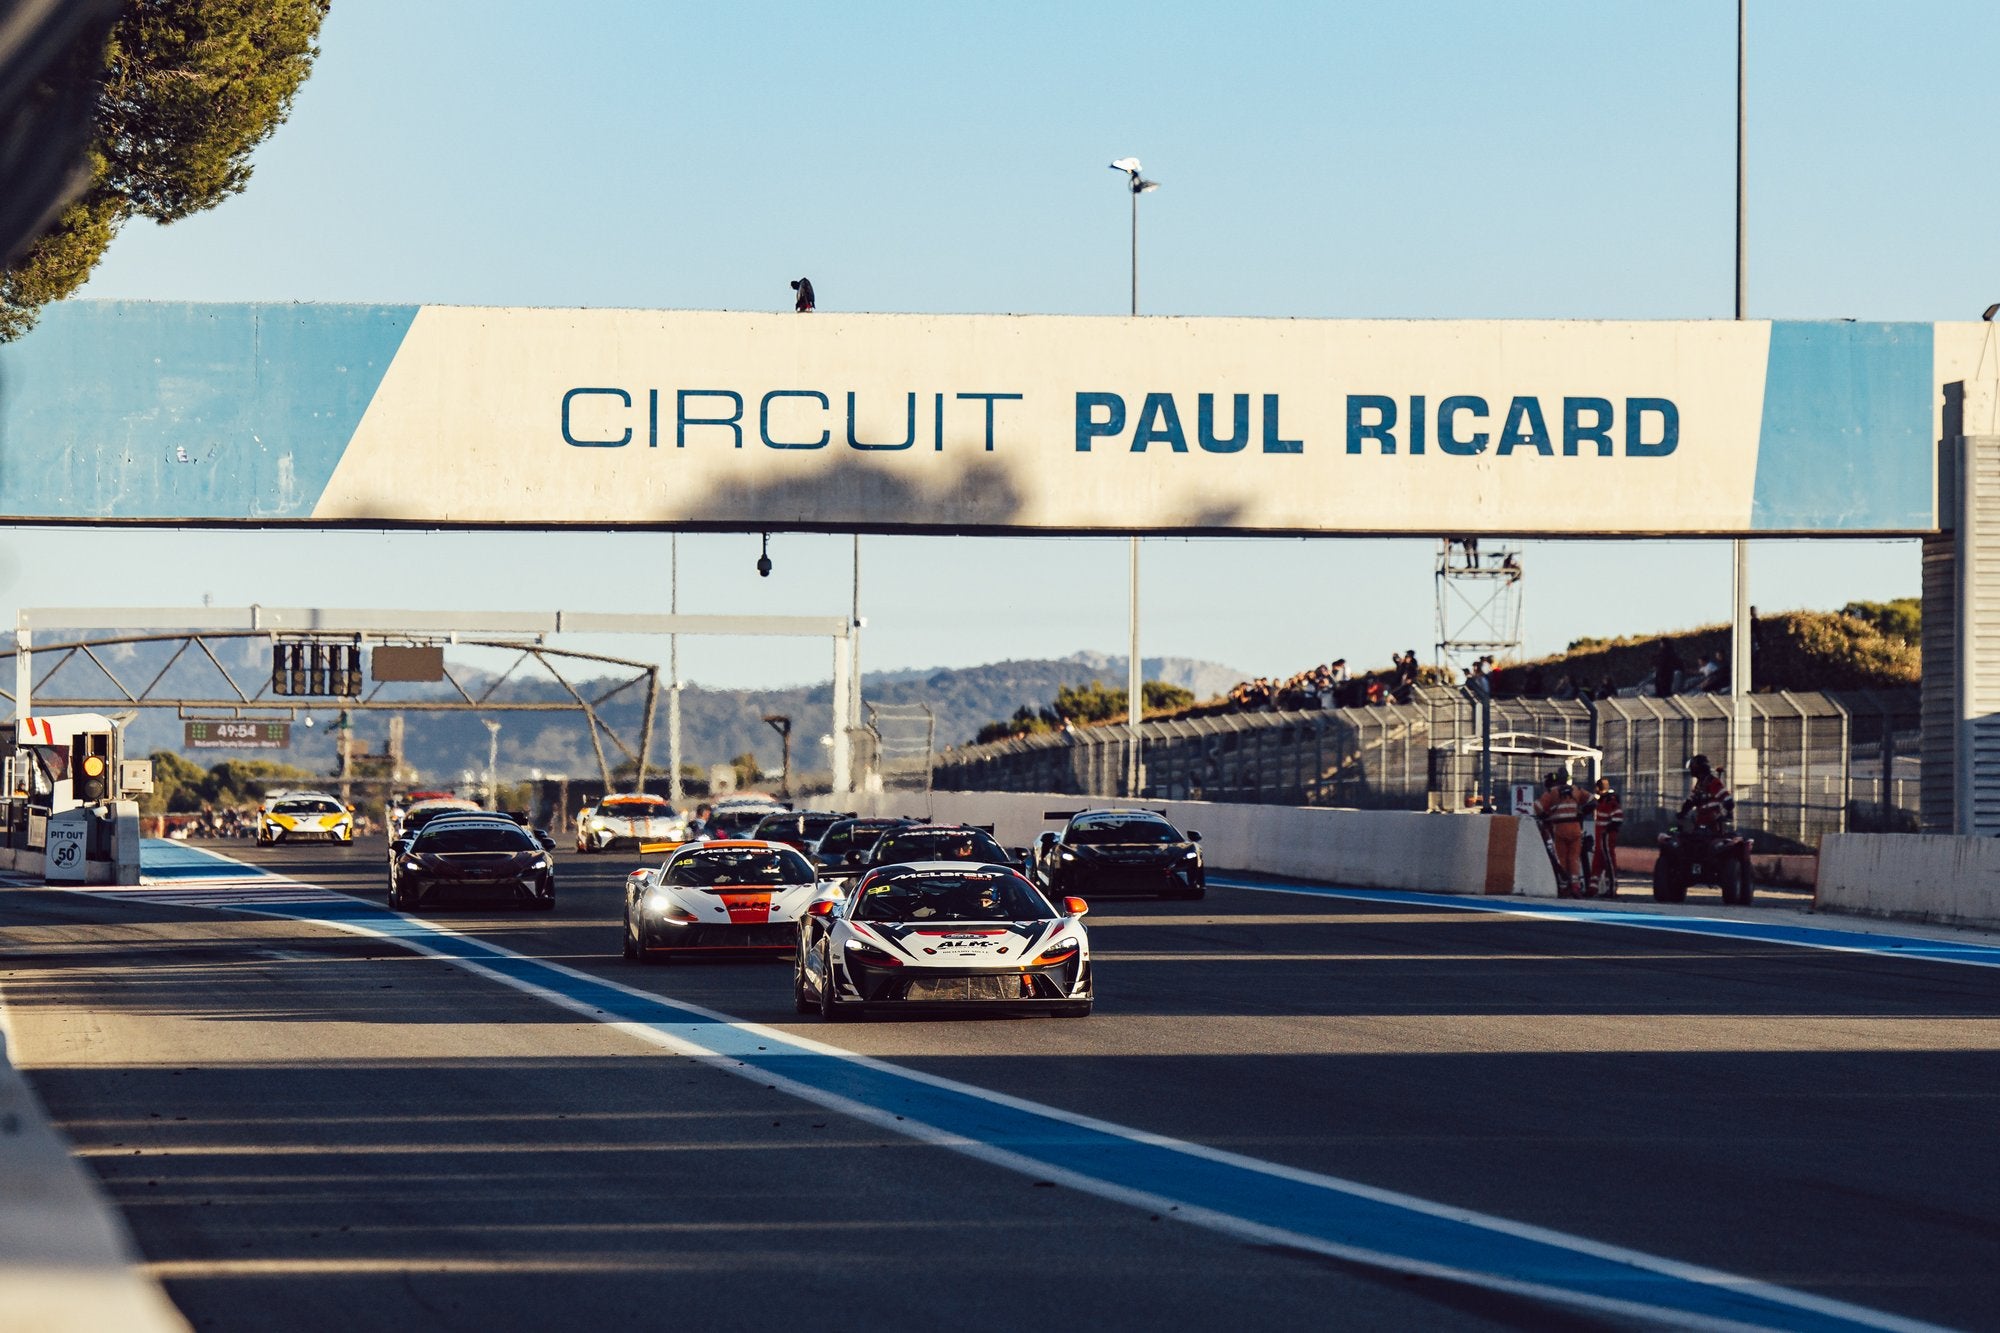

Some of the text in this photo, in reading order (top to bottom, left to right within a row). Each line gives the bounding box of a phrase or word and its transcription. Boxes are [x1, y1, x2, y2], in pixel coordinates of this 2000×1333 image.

[561, 387, 1680, 457] CIRCUIT PAUL RICARD
[217, 724, 257, 738] 49:54
[51, 831, 84, 840] PIT OUT
[58, 848, 75, 862] 50
[692, 848, 774, 856] McLaren
[890, 872, 996, 881] McLaren
[937, 941, 990, 950] ALM
